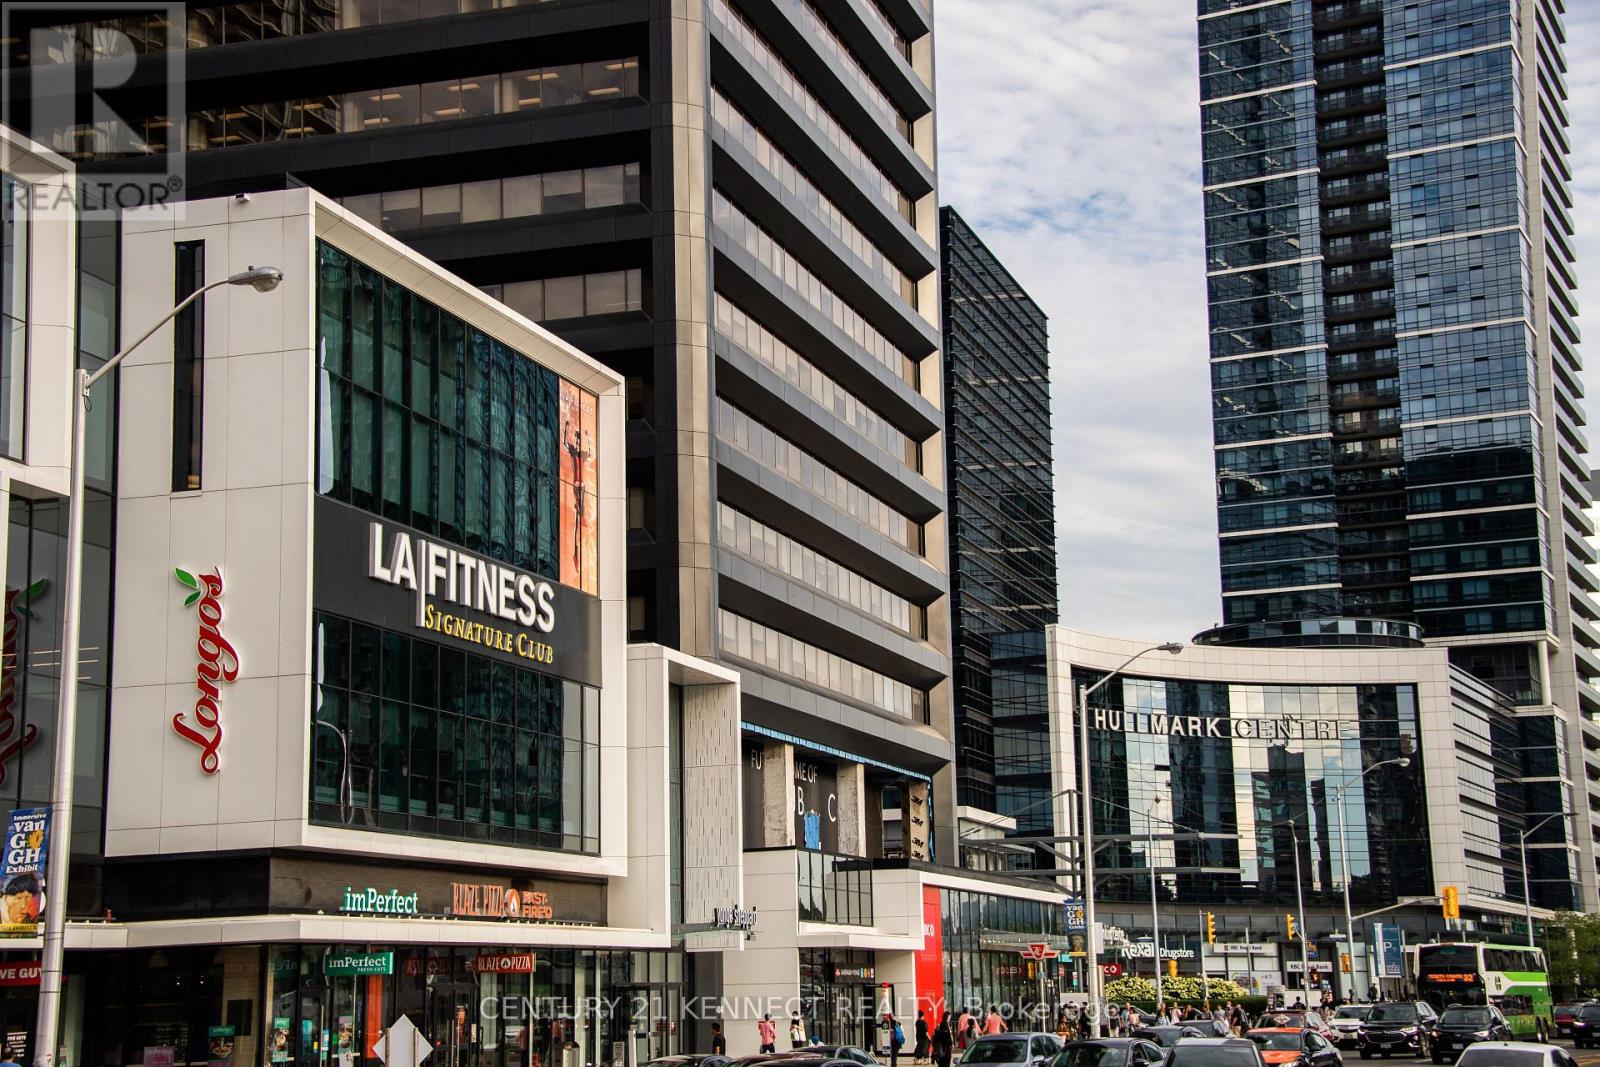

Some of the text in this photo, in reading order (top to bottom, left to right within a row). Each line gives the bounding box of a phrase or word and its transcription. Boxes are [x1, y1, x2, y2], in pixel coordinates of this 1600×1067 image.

[1094, 708, 1352, 740] HULLMARK CENTRE
[14, 820, 46, 832] van
[8, 848, 41, 865] GH
[6, 864, 38, 874] Exhibit
[345, 886, 418, 914] imPerfect
[451, 882, 505, 917] BLAZE PIZZA
[1160, 948, 1194, 960] Drugstore
[329, 956, 386, 968] imPerfect
[478, 956, 531, 971] BLAZE PIZZA
